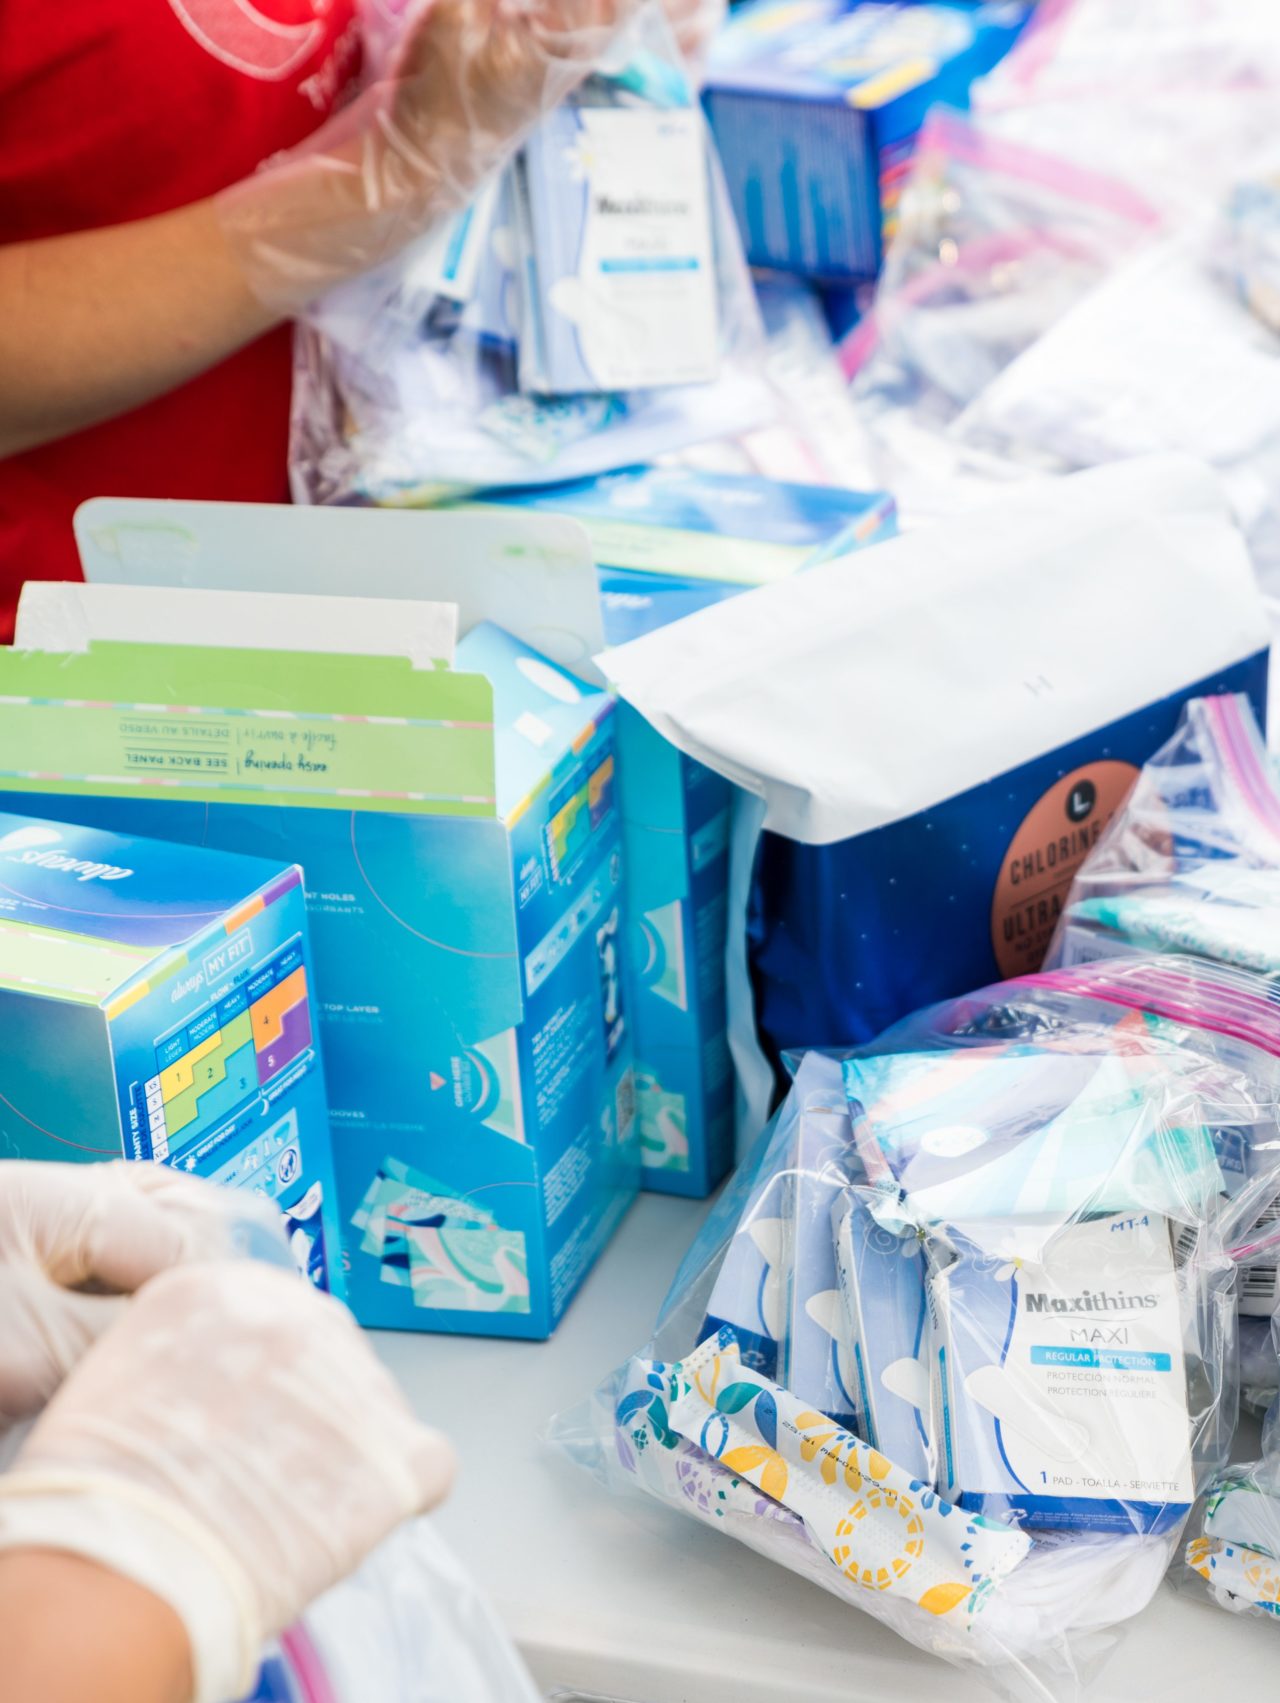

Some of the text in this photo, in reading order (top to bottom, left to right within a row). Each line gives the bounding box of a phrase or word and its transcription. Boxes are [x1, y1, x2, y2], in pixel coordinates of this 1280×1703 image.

[120, 723, 157, 735] VERSO
[162, 725, 177, 735] AU
[124, 752, 227, 767] SEE BACK PANEL
[244, 749, 327, 772] easy opening
[1002, 894, 1061, 943] ULTRA
[171, 941, 247, 1004] always MY FIT
[346, 1005, 380, 1014] LAYER
[129, 1107, 138, 1130] SIZE
[1110, 1215, 1150, 1233] MT-4
[1025, 1290, 1159, 1314] Maxithins
[1070, 1327, 1129, 1345] MAXI
[1045, 1350, 1157, 1367] REGULAR PROTECTION
[1113, 1375, 1157, 1386] NORMAL
[1047, 1386, 1107, 1398] PROTECTION
[1040, 1471, 1180, 1492] 1 PAD TOALLA SERVIETTE
